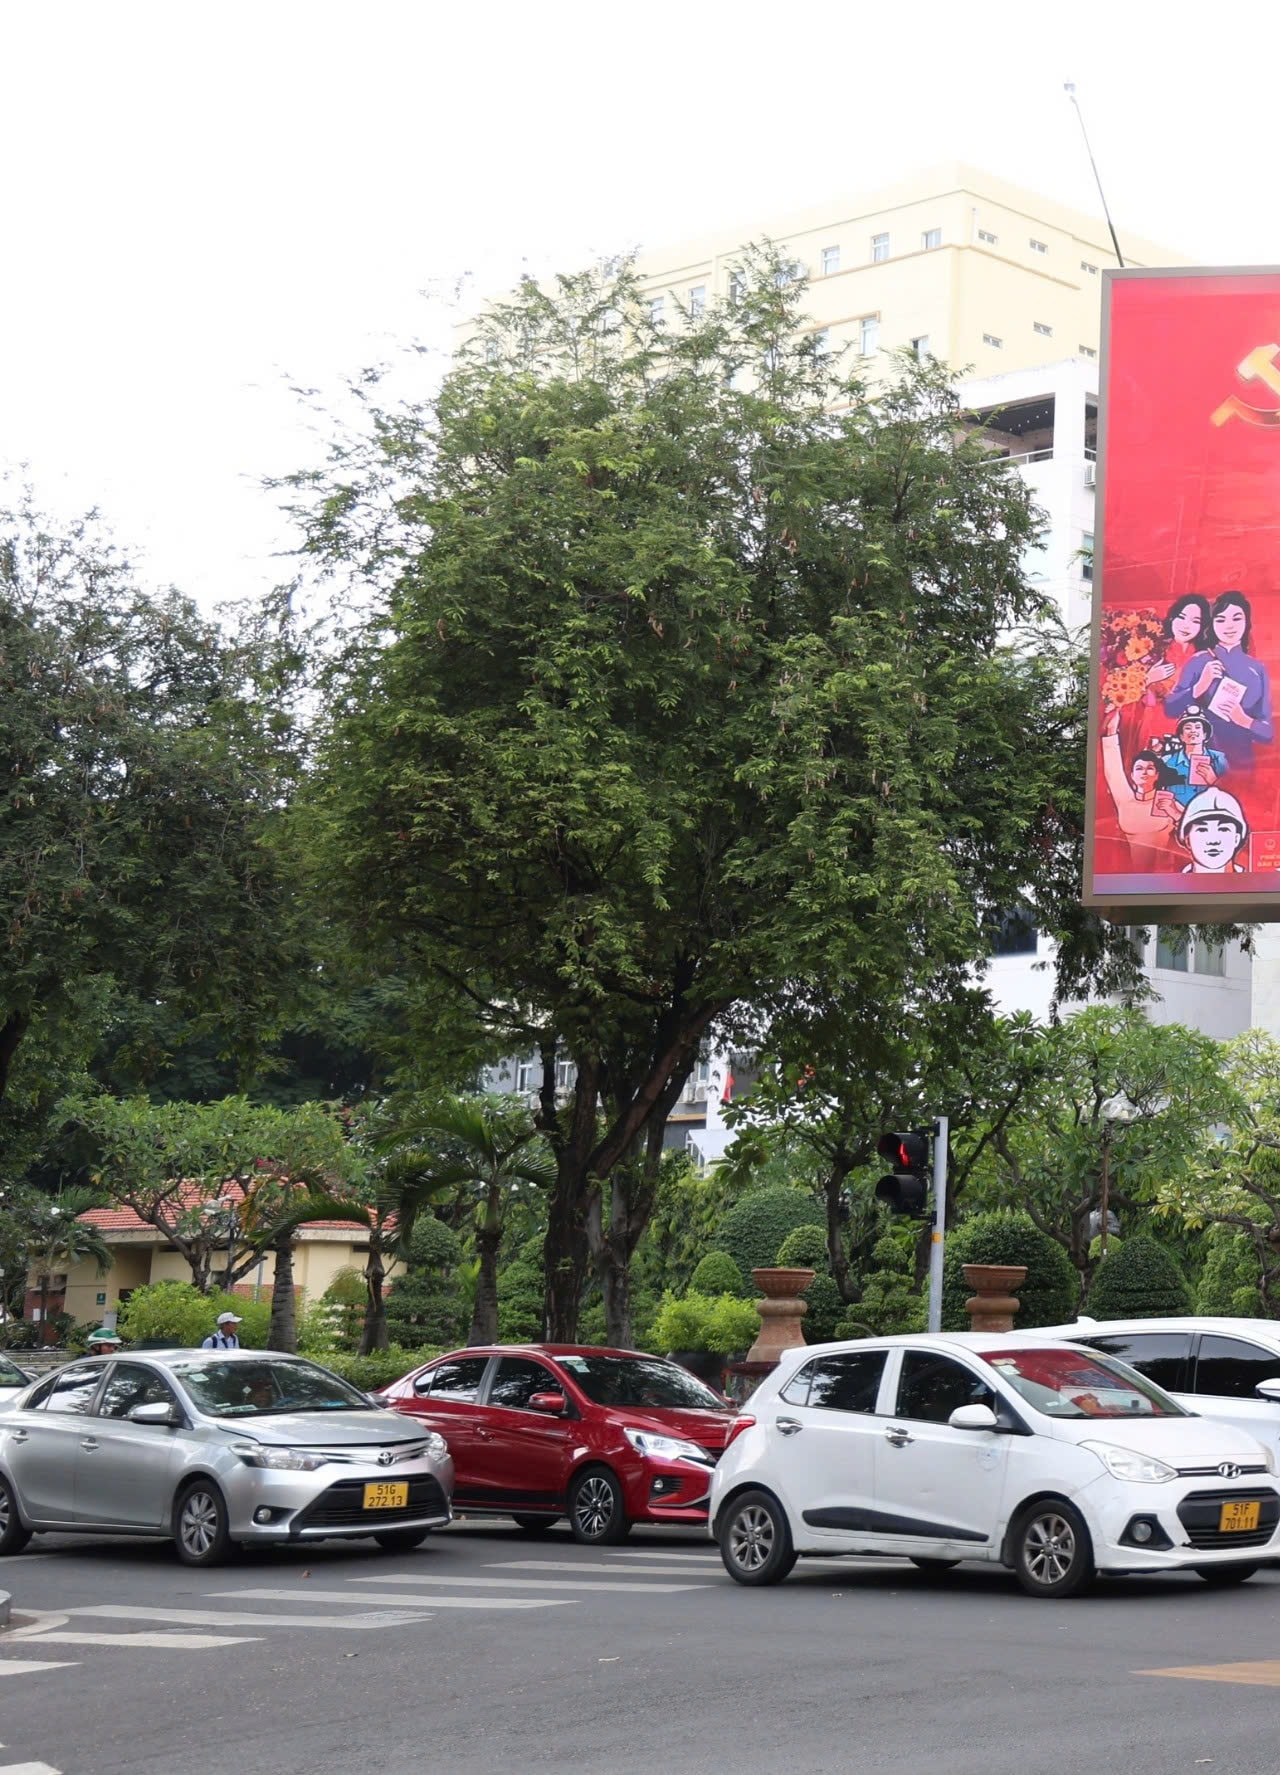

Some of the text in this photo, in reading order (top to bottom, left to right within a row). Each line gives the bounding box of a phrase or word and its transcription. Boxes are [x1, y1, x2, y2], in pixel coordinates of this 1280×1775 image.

[377, 1484, 396, 1495] 51G
[368, 1495, 403, 1507] 272.13
[1233, 1503, 1250, 1516] 51F
[1225, 1516, 1254, 1530] 701.11
